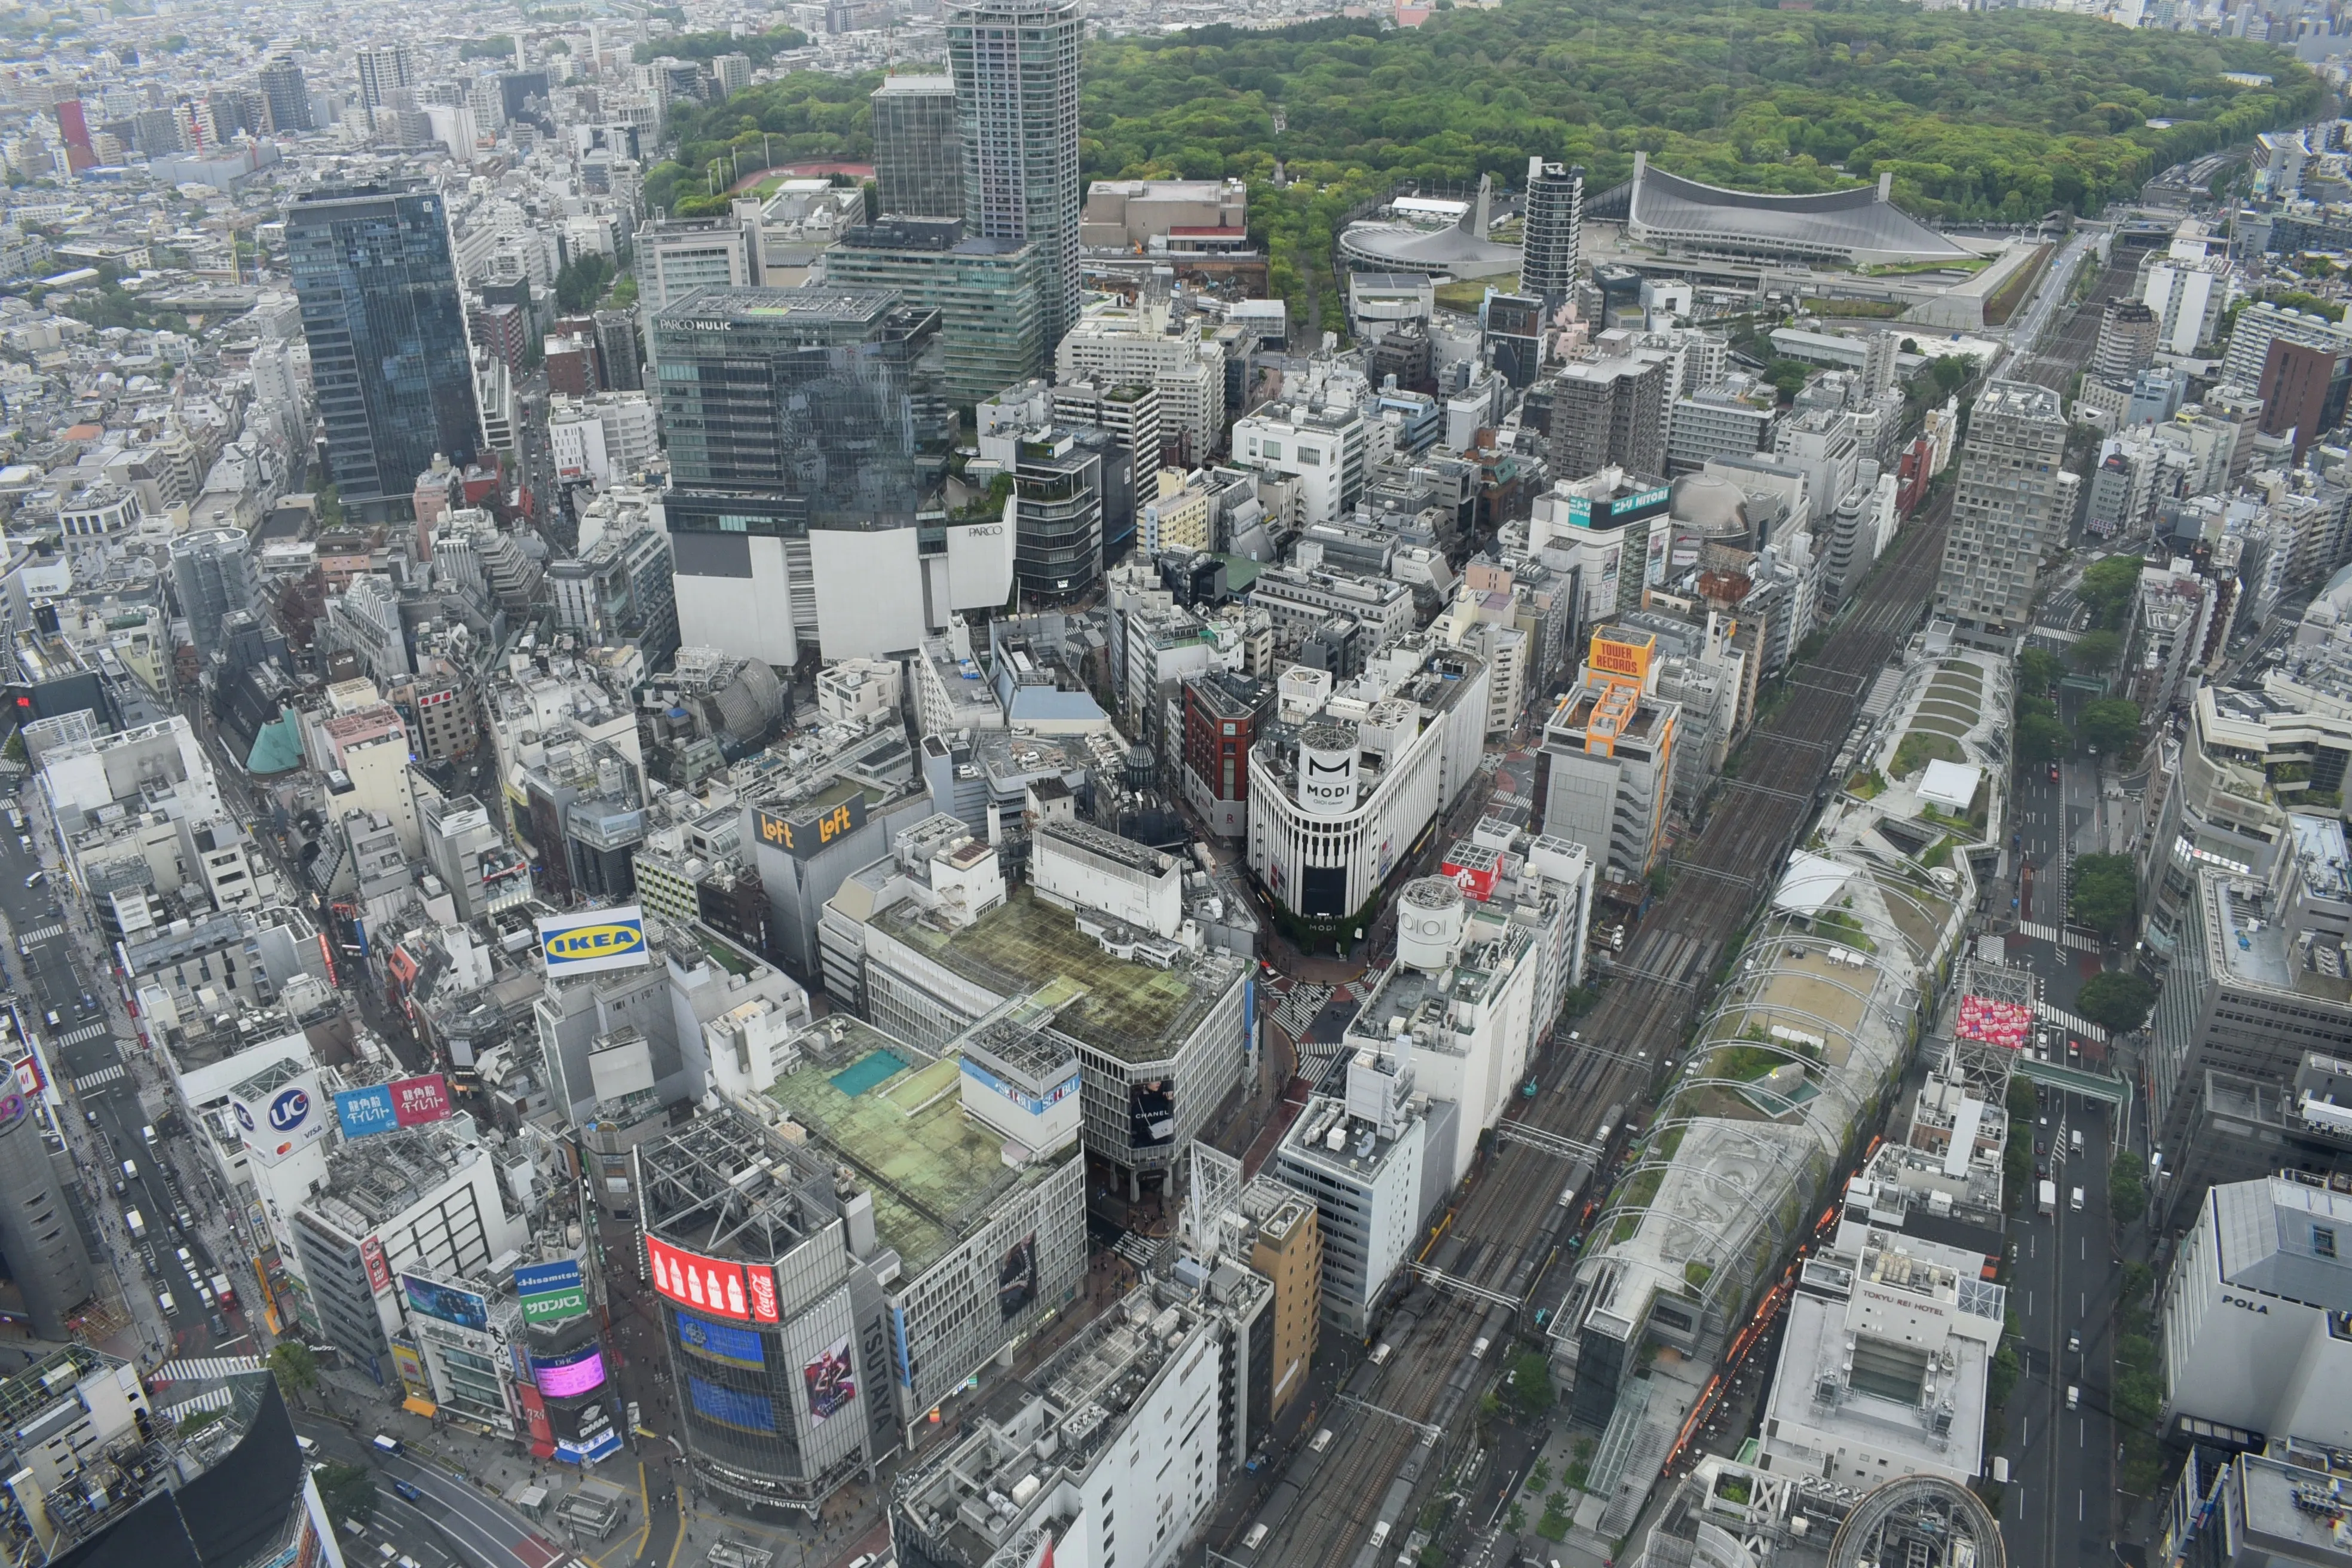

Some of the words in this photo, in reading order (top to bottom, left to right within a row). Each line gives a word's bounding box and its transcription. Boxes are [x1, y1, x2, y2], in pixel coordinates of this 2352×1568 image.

[660, 318, 694, 330] PARCO
[696, 321, 731, 330] HULIC
[1570, 498, 1591, 510] ニトリ
[1614, 499, 1633, 513] ニトリ
[1636, 489, 1668, 507] NITORI
[1570, 508, 1591, 517] NITORI
[969, 526, 1003, 537] PARCO
[1601, 643, 1632, 660] TOWER
[1596, 655, 1637, 673] RECORDS
[1307, 784, 1349, 798] MODI
[1226, 813, 1234, 823] R
[554, 930, 635, 953] IKEA
[999, 1083, 1031, 1111] SEIBU
[1043, 1078, 1076, 1110] SEIBU
[1135, 1110, 1169, 1119] CHANEL
[304, 1125, 323, 1139] VISA
[517, 1272, 578, 1287] Hisamitsu
[751, 1272, 776, 1318] Coca-Cola
[1863, 1290, 1894, 1303] TOKYU
[1897, 1298, 1912, 1307] REI
[1914, 1303, 1944, 1316] HOTEL
[526, 1294, 583, 1315] サロンパス
[2222, 1294, 2269, 1315] POLA
[554, 1356, 574, 1367] DHC
[863, 1313, 892, 1434] TSUTAYA
[578, 1414, 610, 1438] DMM
[768, 1500, 807, 1509] TSUTAYA
